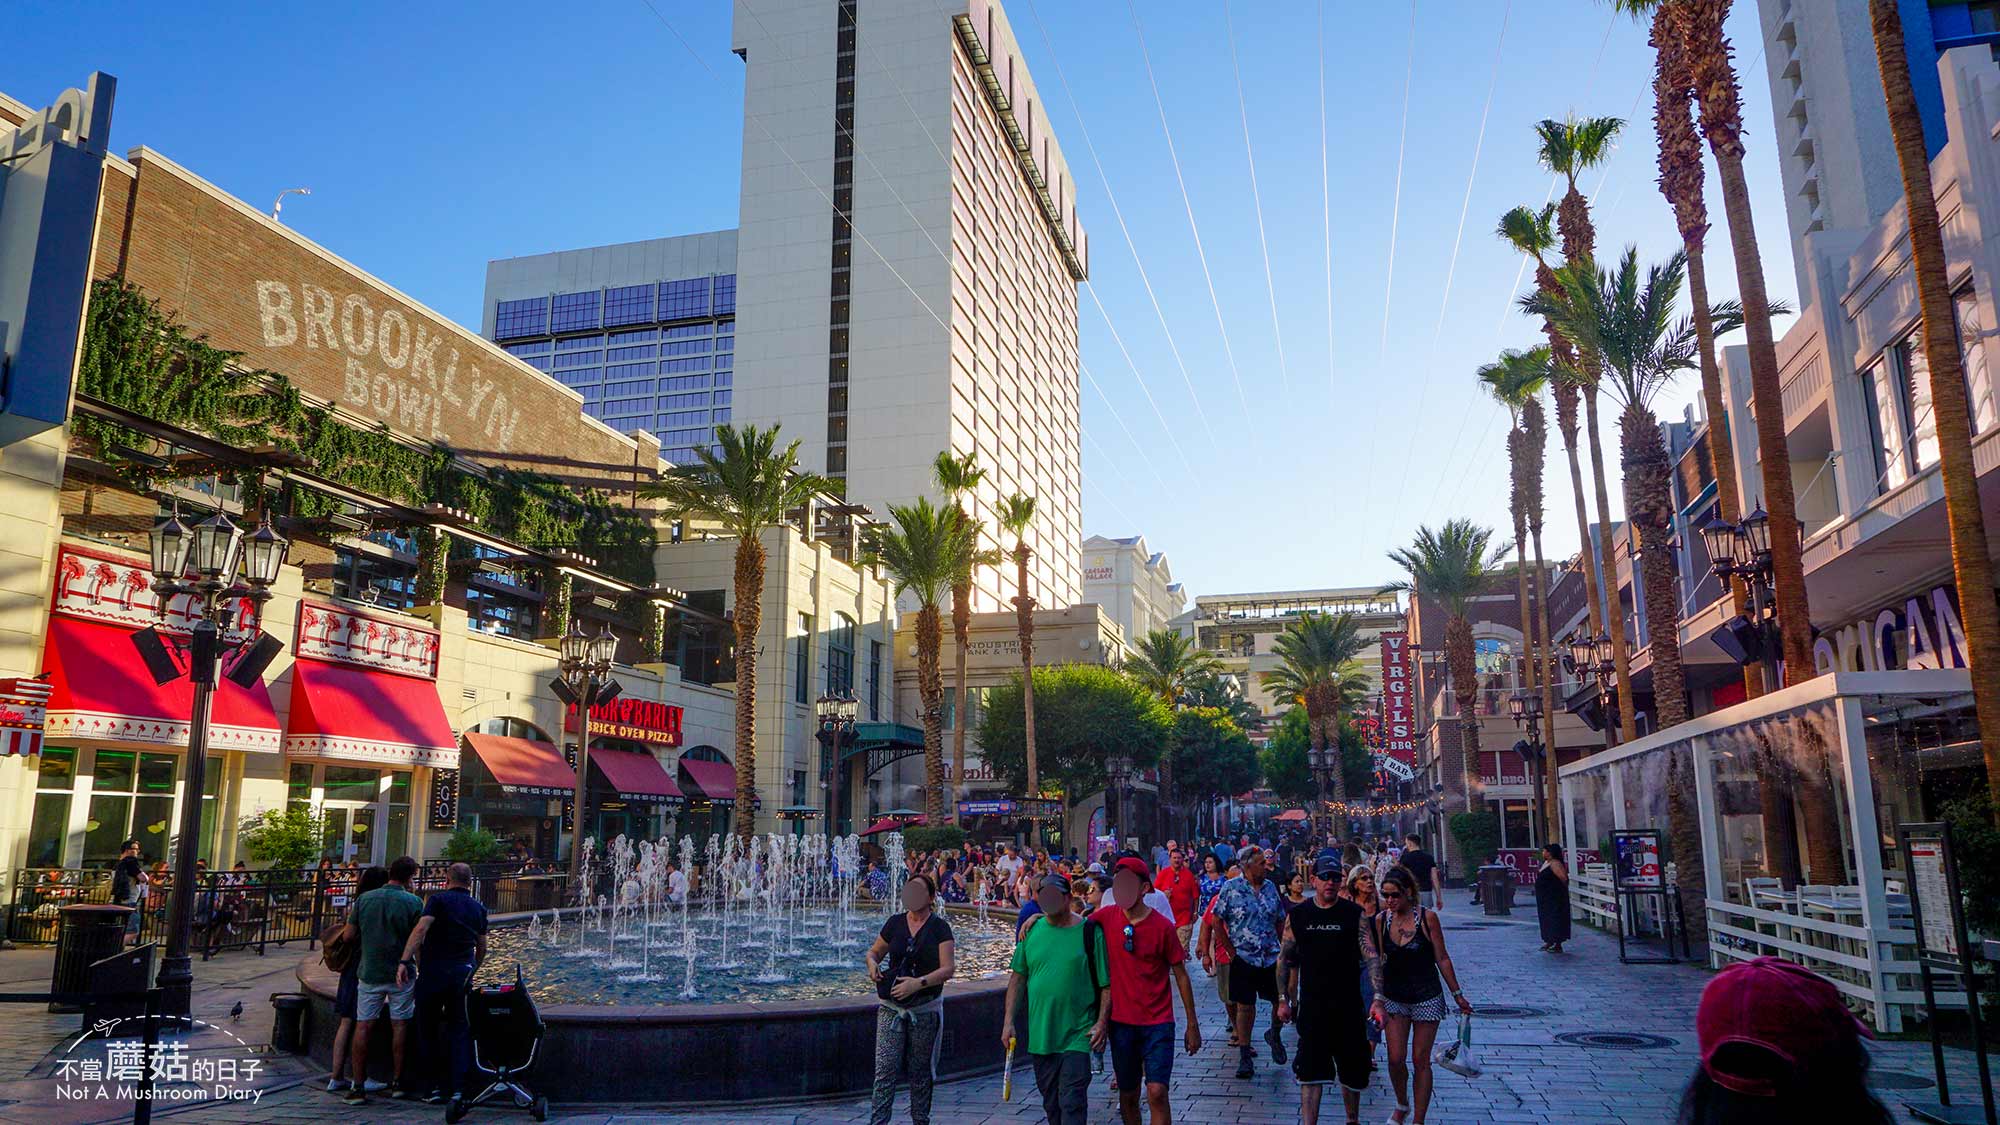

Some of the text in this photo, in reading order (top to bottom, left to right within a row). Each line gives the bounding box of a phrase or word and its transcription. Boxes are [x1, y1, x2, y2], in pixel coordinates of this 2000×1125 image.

[256, 280, 520, 451] BROOKLYN
[344, 356, 450, 442] BOWL
[1005, 646, 1037, 654] TRUT
[634, 699, 684, 732] BARLEY
[619, 725, 645, 739] OVEN
[647, 730, 674, 744] PIZZA
[1391, 740, 1412, 750] BBQ
[1389, 761, 1409, 776] BAR
